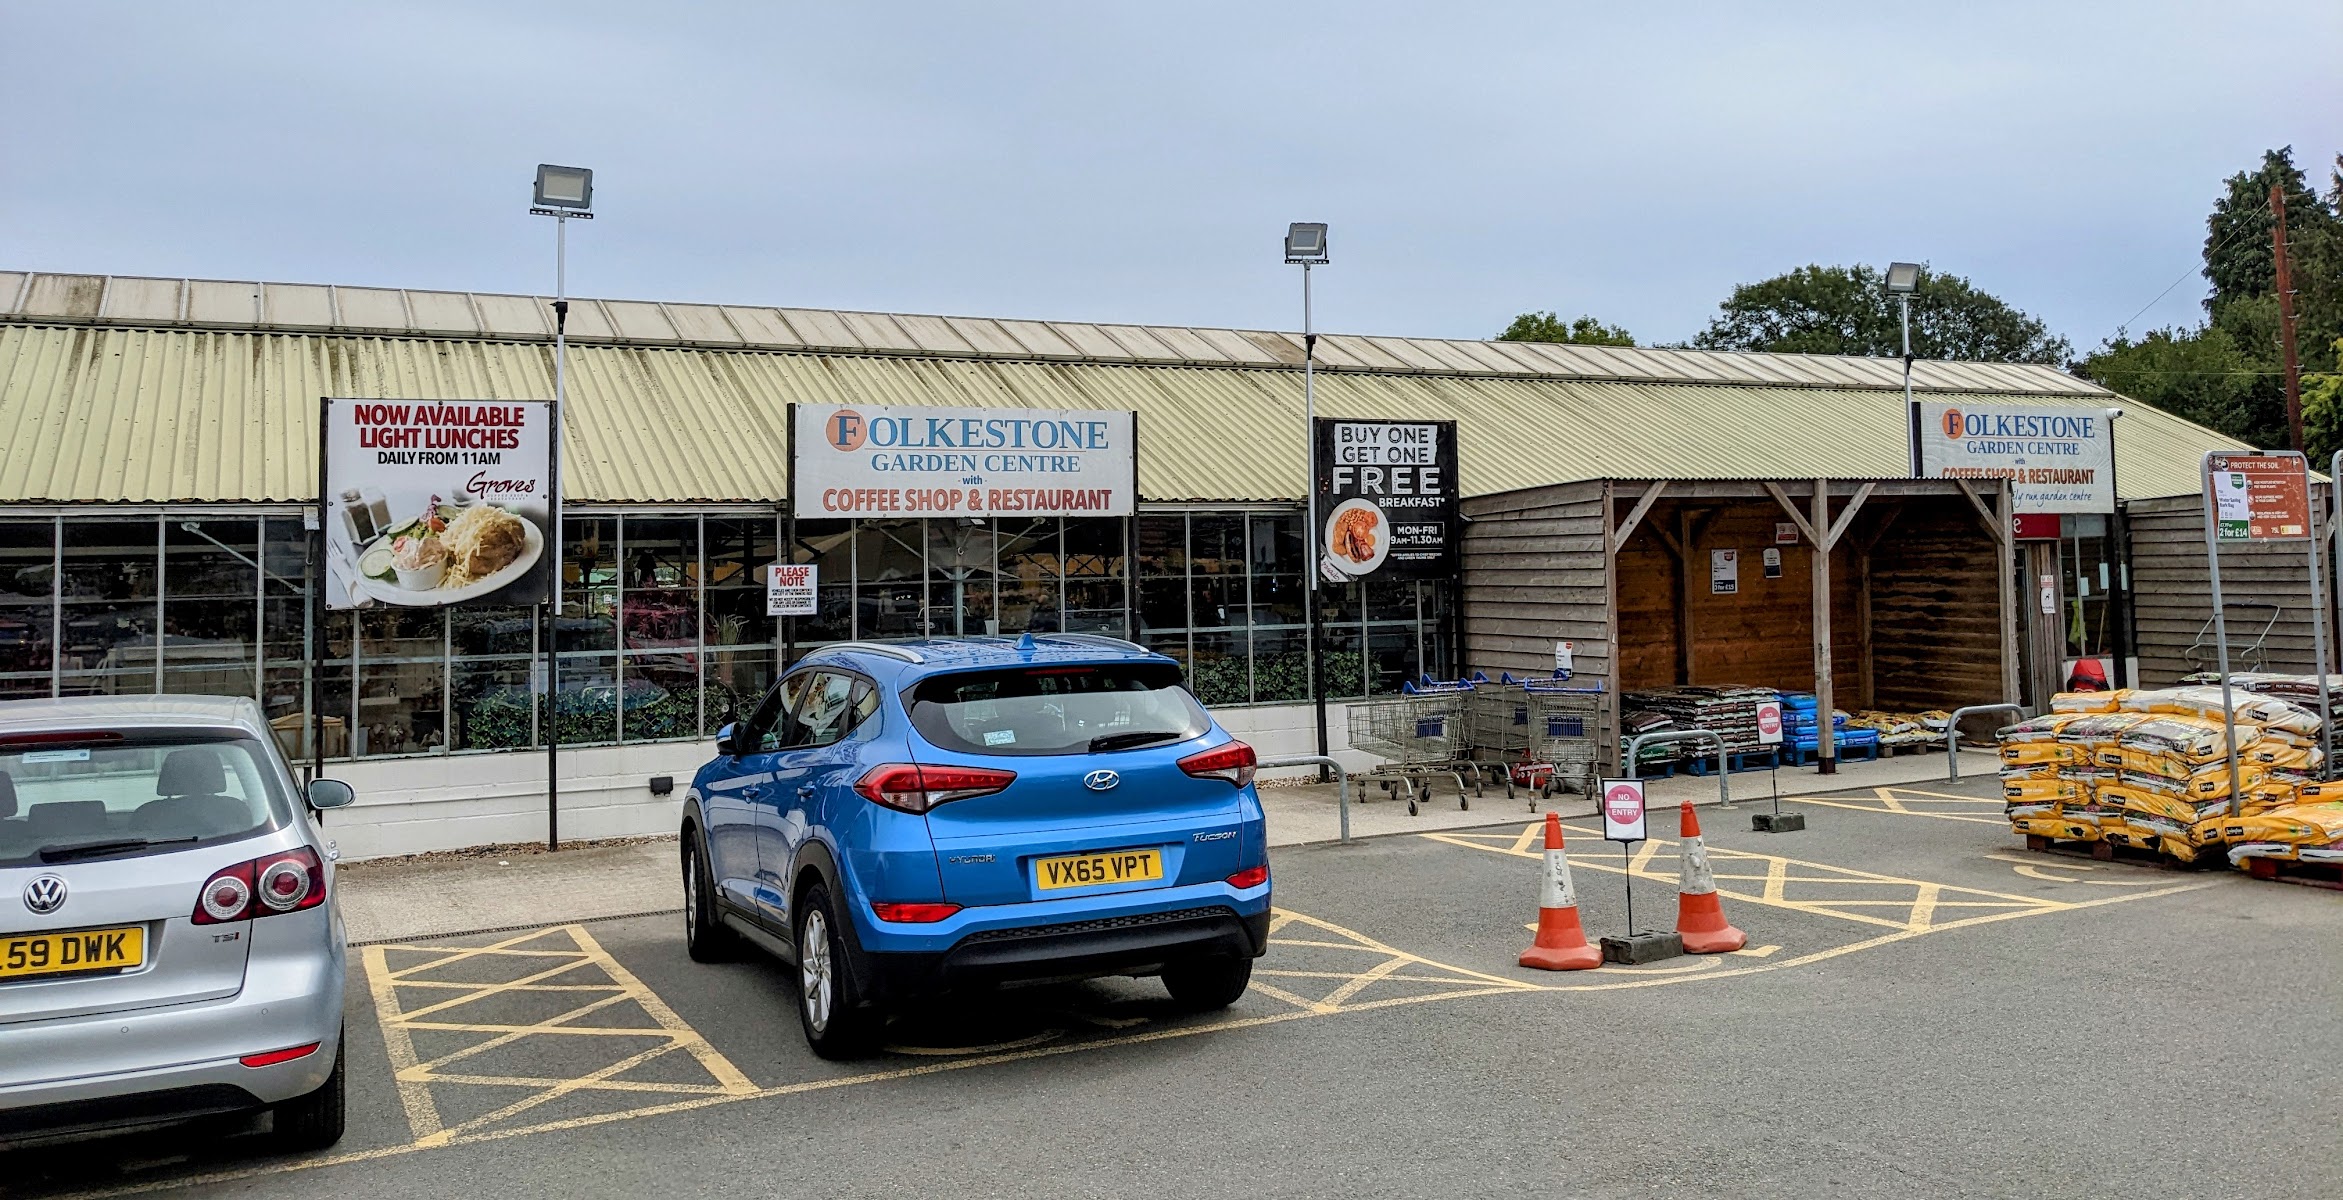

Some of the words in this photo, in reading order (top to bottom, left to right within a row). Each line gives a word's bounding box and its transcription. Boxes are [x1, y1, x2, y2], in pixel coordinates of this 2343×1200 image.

[354, 404, 412, 426] NOW
[413, 406, 525, 427] AVAILABLE
[836, 415, 1109, 449] FOLKESTONE
[1947, 413, 2096, 438] FOLKESTONE
[360, 427, 422, 449] LIGHT
[425, 428, 519, 450] LUNCHES
[1341, 426, 1382, 444] BUY
[1387, 426, 1429, 444] ONE
[1342, 446, 1381, 463] GET
[1387, 447, 1429, 463] ONE
[1967, 440, 2025, 455] GARDEN
[2027, 441, 2080, 456] CENTRE
[377, 451, 416, 465] DAILY
[418, 451, 458, 465] FROM
[461, 452, 501, 465] 11AM
[871, 453, 978, 472] GARDEN
[984, 454, 1081, 473] CENTRE
[2014, 457, 2026, 465] with
[2230, 461, 2256, 469] PROTECT
[466, 470, 536, 500] Groves
[962, 475, 983, 485] with
[1332, 466, 1441, 495] FREE
[2018, 468, 2027, 484] &
[2028, 468, 2095, 485] RESTAURANT
[822, 488, 901, 512] COFFEE
[905, 488, 963, 512] SHOP
[967, 488, 984, 512] &
[988, 488, 1112, 511] RESTAURANT
[2037, 490, 2067, 508] garden
[2069, 489, 2092, 501] centre
[1397, 525, 1438, 535] MON-FRI
[2219, 527, 2224, 537] 2
[2224, 527, 2235, 538] for
[2235, 527, 2248, 537] £14
[775, 567, 810, 577] PLEASE
[779, 577, 805, 587] NOTE
[1762, 722, 1778, 730] ENTRY
[1611, 808, 1638, 816] ENTRY
[1192, 831, 1237, 842] TUCSON
[1046, 858, 1105, 885] VX65
[1110, 854, 1151, 879] VPT
[0, 939, 50, 971] 59
[60, 933, 126, 965] DWK
